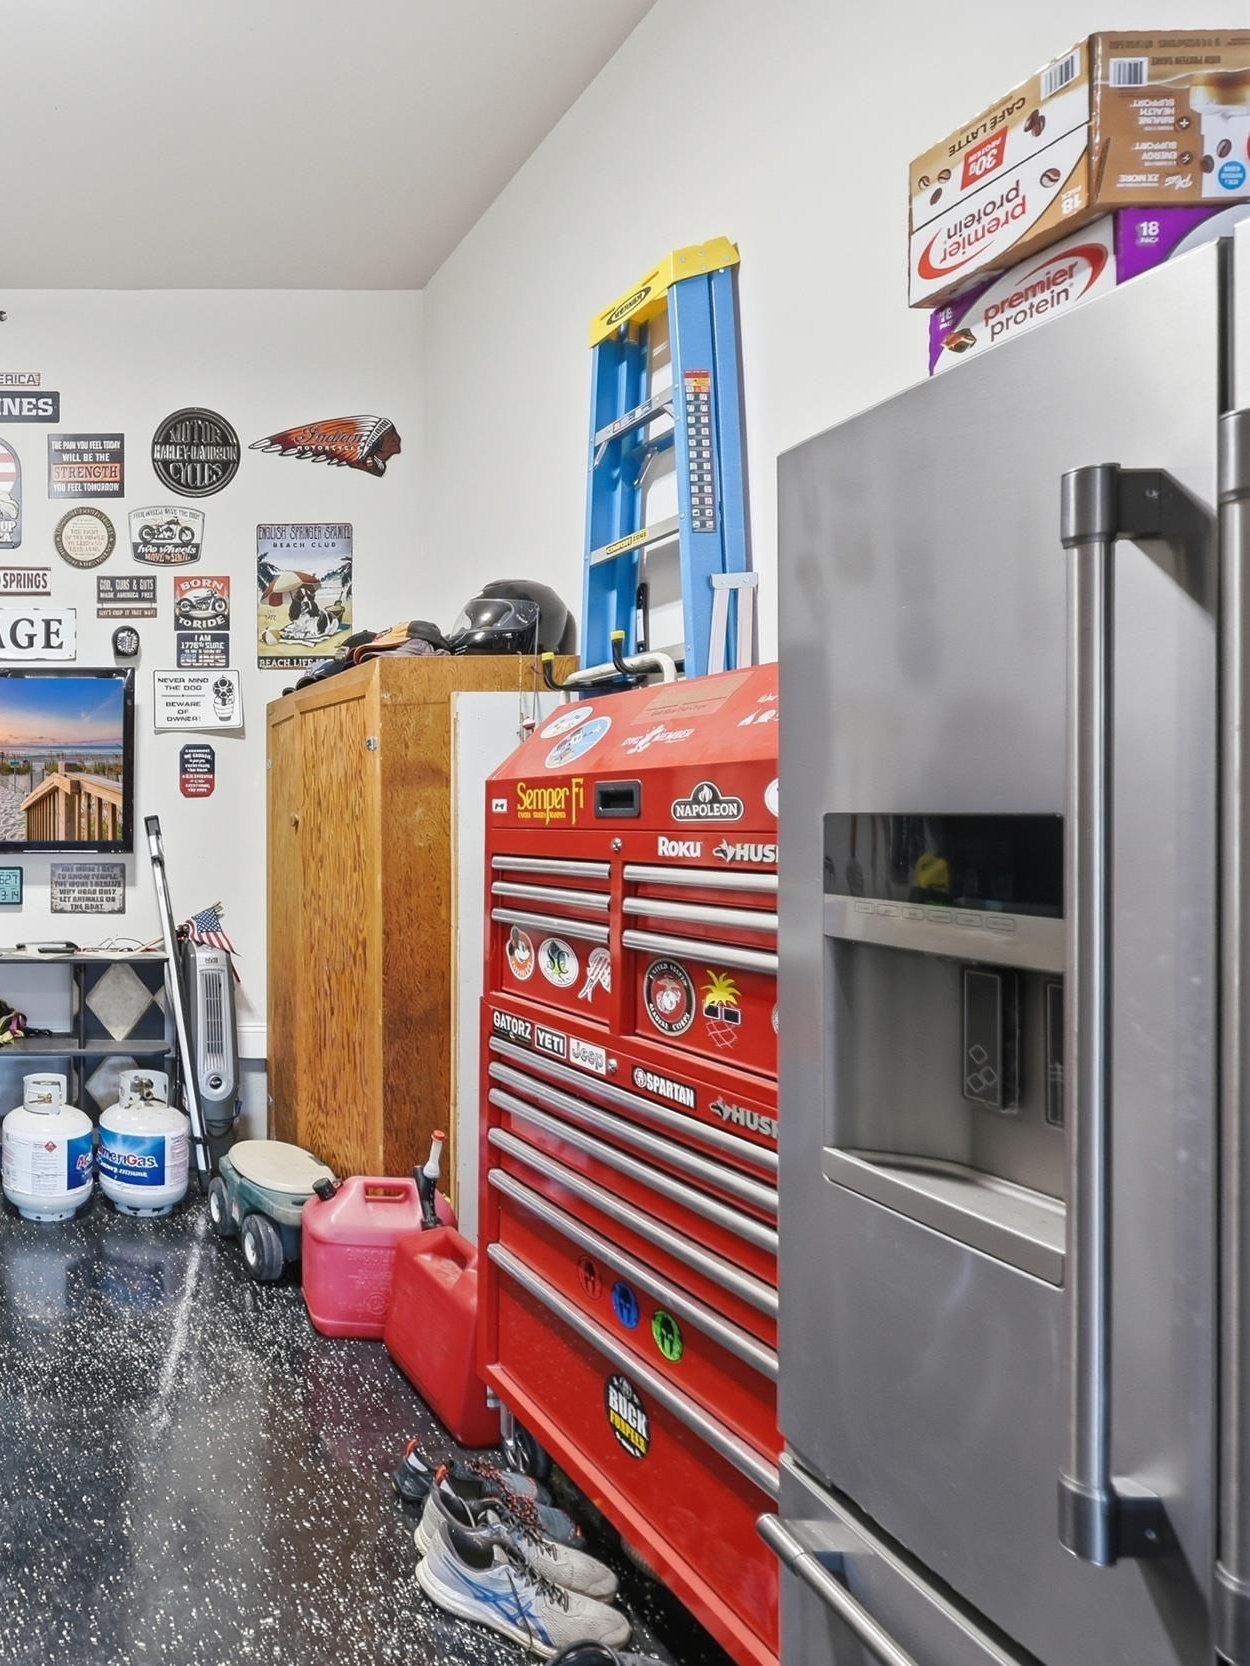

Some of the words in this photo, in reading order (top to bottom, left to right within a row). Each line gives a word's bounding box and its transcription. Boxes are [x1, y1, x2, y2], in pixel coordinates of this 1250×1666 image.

[990, 97, 1026, 131] CAFÉ
[948, 123, 987, 157] LATTE
[969, 149, 998, 176] 30g
[1142, 150, 1177, 159] ENERGY
[946, 180, 1021, 240] protein
[1061, 194, 1082, 214] 18
[939, 191, 1027, 264] premier
[1137, 221, 1160, 236] 18
[983, 261, 1079, 327] premier
[990, 287, 1070, 342] protein
[296, 426, 364, 444] Indian
[52, 441, 62, 450] THE
[76, 441, 89, 450] YOU
[89, 441, 102, 450] FEEL
[102, 441, 121, 450] TODAY
[154, 444, 238, 461] HARLEY-DAVIDSON
[62, 453, 81, 462] WILL
[83, 453, 93, 462] BE
[95, 453, 110, 462] THE
[54, 465, 118, 479] STRENGTH
[170, 462, 223, 487] CYCLES
[54, 483, 66, 492] YOU
[67, 483, 82, 492] FEEL
[83, 483, 119, 492] TOMORROW
[0, 520, 17, 532] UP
[258, 526, 287, 540] ENGLISH
[289, 526, 322, 541] SPRINGER
[324, 526, 351, 540] SPANIEL
[137, 544, 158, 554] two
[159, 544, 197, 557] wheels
[273, 541, 306, 549] BEACH
[311, 541, 337, 549] CLUB
[2, 572, 48, 590] SPRINGS
[99, 579, 113, 591] GOD,
[115, 579, 130, 590] GUNS
[132, 579, 138, 590] &
[139, 579, 154, 590] GUTS
[180, 578, 224, 590] BORN
[178, 616, 191, 628] TO
[191, 615, 226, 630] RIDE
[194, 634, 198, 642] I
[199, 634, 211, 642] AM
[258, 658, 290, 668] BEACH
[517, 782, 570, 825] Semper
[571, 778, 584, 825] Fi
[675, 803, 738, 817] NAPOLEON
[735, 843, 779, 862] HUS
[70, 903, 84, 911] THE
[493, 1011, 532, 1040] GATORZ
[672, 1012, 691, 1032] CORPS
[537, 1028, 564, 1054] YETI
[571, 1041, 605, 1071] Jeep
[646, 1072, 695, 1108] SPARTAN
[97, 1144, 158, 1168] AmeriGas
[608, 1385, 649, 1441] BUCK
